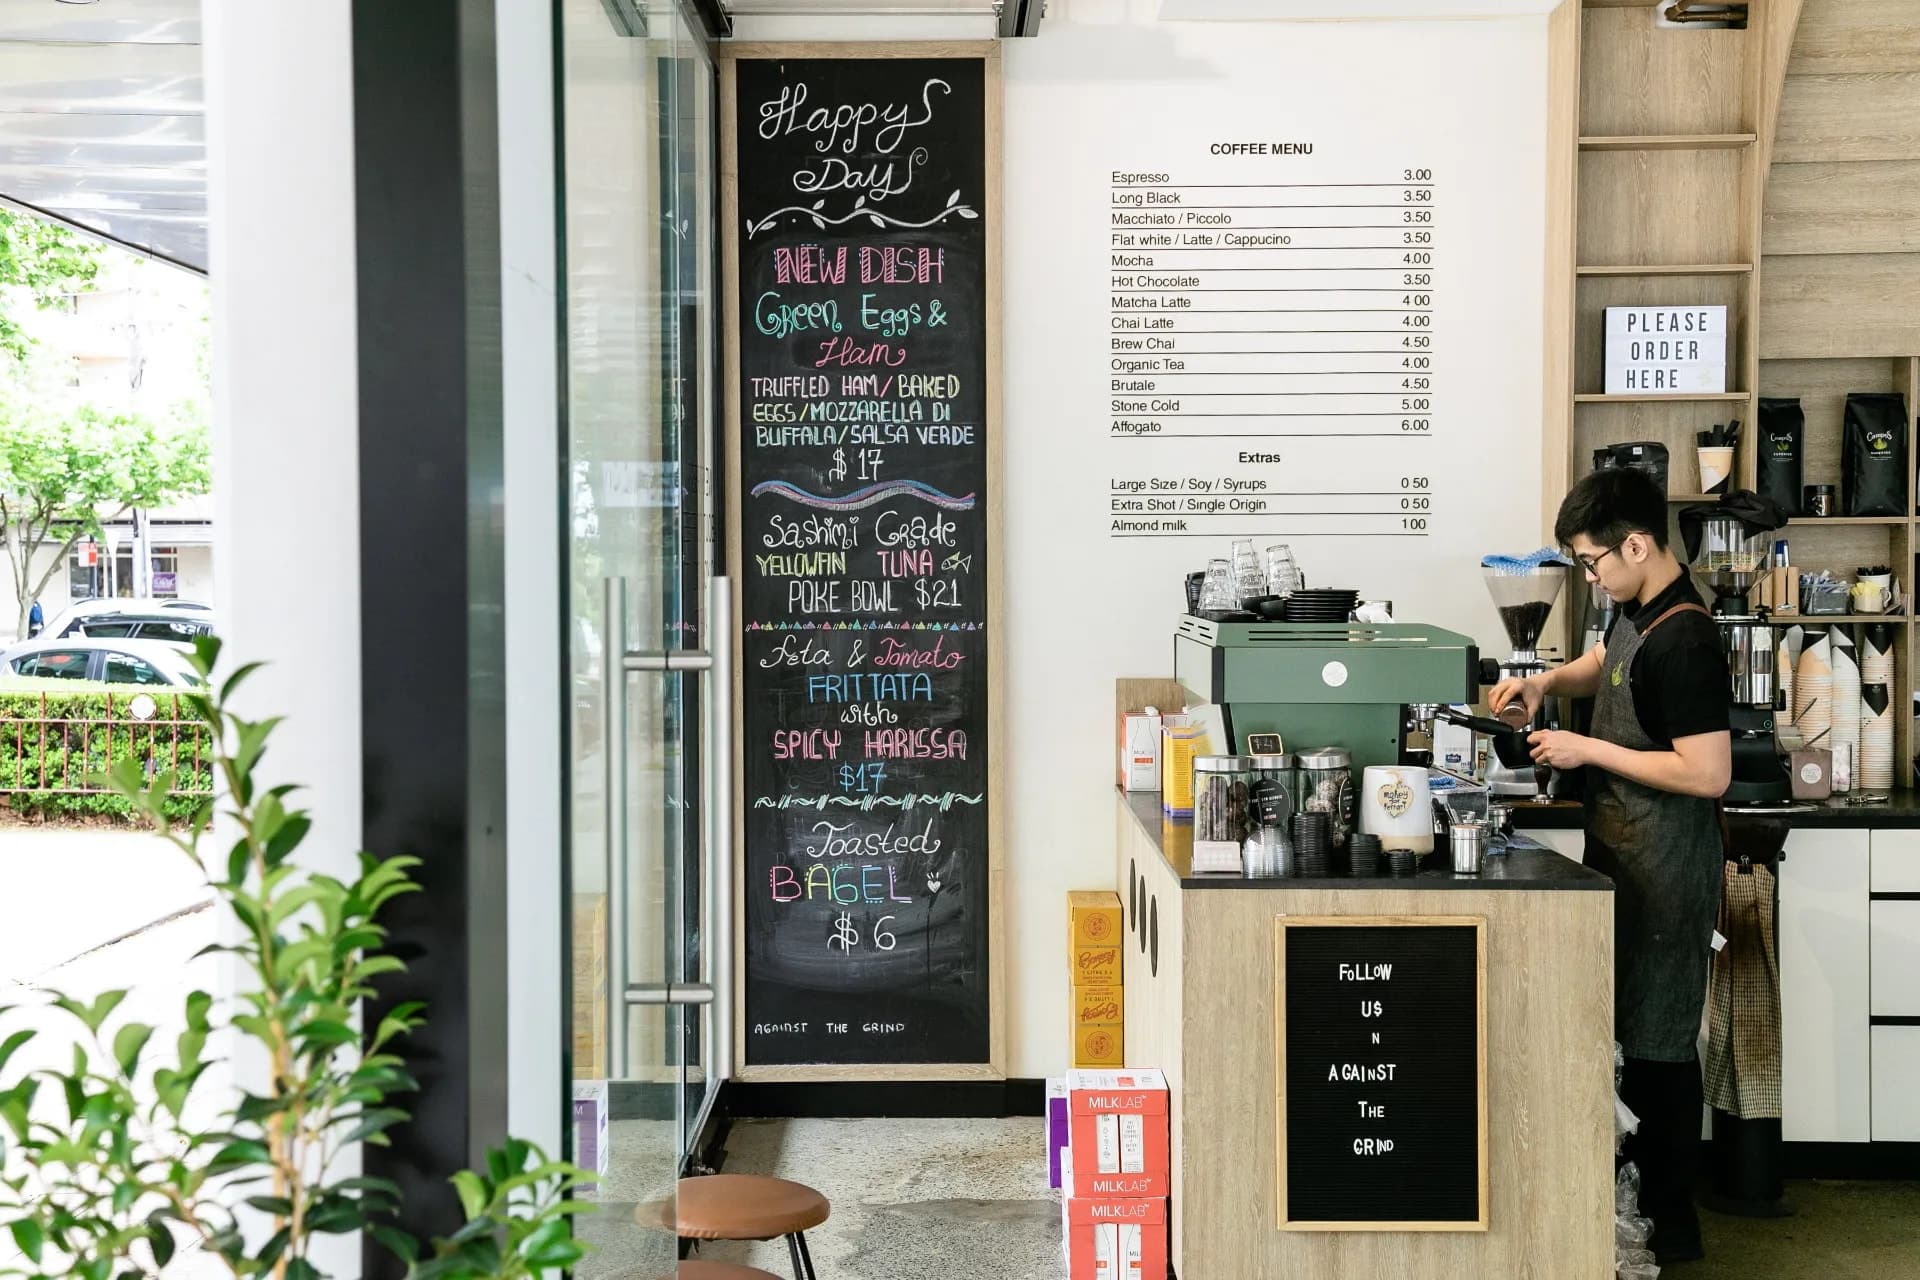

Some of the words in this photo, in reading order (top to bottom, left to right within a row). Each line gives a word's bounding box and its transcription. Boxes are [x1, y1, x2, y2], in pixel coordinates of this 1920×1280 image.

[759, 79, 951, 153] Happy
[1211, 143, 1268, 156] COFFEE
[1272, 143, 1313, 156] MENU
[1111, 171, 1170, 186] Espresso
[1403, 168, 1432, 182] 3.00
[1111, 191, 1143, 207] Long
[1146, 191, 1181, 204] Black
[1403, 189, 1432, 203] 3.50
[1111, 212, 1176, 225] Macchiato
[1186, 212, 1232, 225] Piccolo
[1403, 210, 1432, 223] 3.50
[1111, 233, 1135, 247] Flat
[1139, 233, 1172, 247] white
[1183, 233, 1213, 246] Latte
[1224, 233, 1292, 249] Cappucino
[1403, 231, 1431, 244] 3.50
[775, 245, 848, 284] NEW
[859, 246, 945, 284] DISH
[1111, 254, 1154, 268] Mocha
[1402, 252, 1431, 265] 4.00
[1111, 275, 1134, 288] Hot
[1136, 275, 1200, 288] Chocolate
[1403, 273, 1431, 286] 3.50
[1111, 296, 1158, 309] Matcha
[1161, 295, 1192, 309] Latte
[860, 293, 922, 336] Eggs
[928, 299, 948, 327] &
[1111, 316, 1140, 329] Chai
[1144, 316, 1175, 329] Latte
[1402, 315, 1430, 328] 4.00
[1627, 312, 1707, 332] PLEASE
[815, 336, 906, 368] Ham
[1111, 337, 1143, 351] Brew
[1146, 337, 1175, 351] Chai
[1401, 336, 1430, 348] 4.50
[1630, 340, 1698, 360] ORDER
[1111, 357, 1161, 374] Organic
[1162, 358, 1185, 371] Tea
[1401, 356, 1430, 369] 4.00
[751, 375, 830, 399] TRUFFLED
[1111, 378, 1156, 392] Brutale
[1401, 377, 1430, 390] 4.50
[1625, 369, 1679, 389] HERE
[932, 402, 951, 423] DI
[1111, 399, 1148, 413] Stone
[1150, 399, 1180, 413] Cold
[1401, 398, 1430, 411] 5.00
[916, 426, 976, 445] VERDE
[1111, 420, 1162, 435] Affogato
[1401, 418, 1430, 431] 6.00
[1238, 451, 1281, 464] Extras
[1111, 478, 1147, 494] Large
[1188, 477, 1213, 493] Soy
[1223, 477, 1267, 493] Syrups
[1111, 498, 1144, 511] Extra
[1146, 498, 1177, 511] Shot
[1229, 498, 1267, 513] Origin
[763, 513, 860, 549] Sashimi
[1111, 519, 1159, 532] Almond
[755, 551, 847, 577] YELLOWFIN
[877, 549, 934, 578] TUNA
[788, 580, 841, 613] POKE
[851, 580, 899, 613] BOWL
[914, 578, 962, 610] $21
[760, 634, 834, 668] Feta
[847, 639, 867, 668] &
[874, 634, 967, 668] Tomato
[808, 672, 933, 703] FRITTATA
[841, 701, 898, 726] with
[774, 729, 842, 760] SPICY
[865, 728, 967, 761] HARISSA
[839, 761, 887, 793] $17
[806, 818, 941, 858] Toasted
[770, 864, 913, 905] BAGEL
[826, 1022, 849, 1034] THE
[862, 1022, 905, 1033] GRIND
[1371, 1032, 1380, 1045] N
